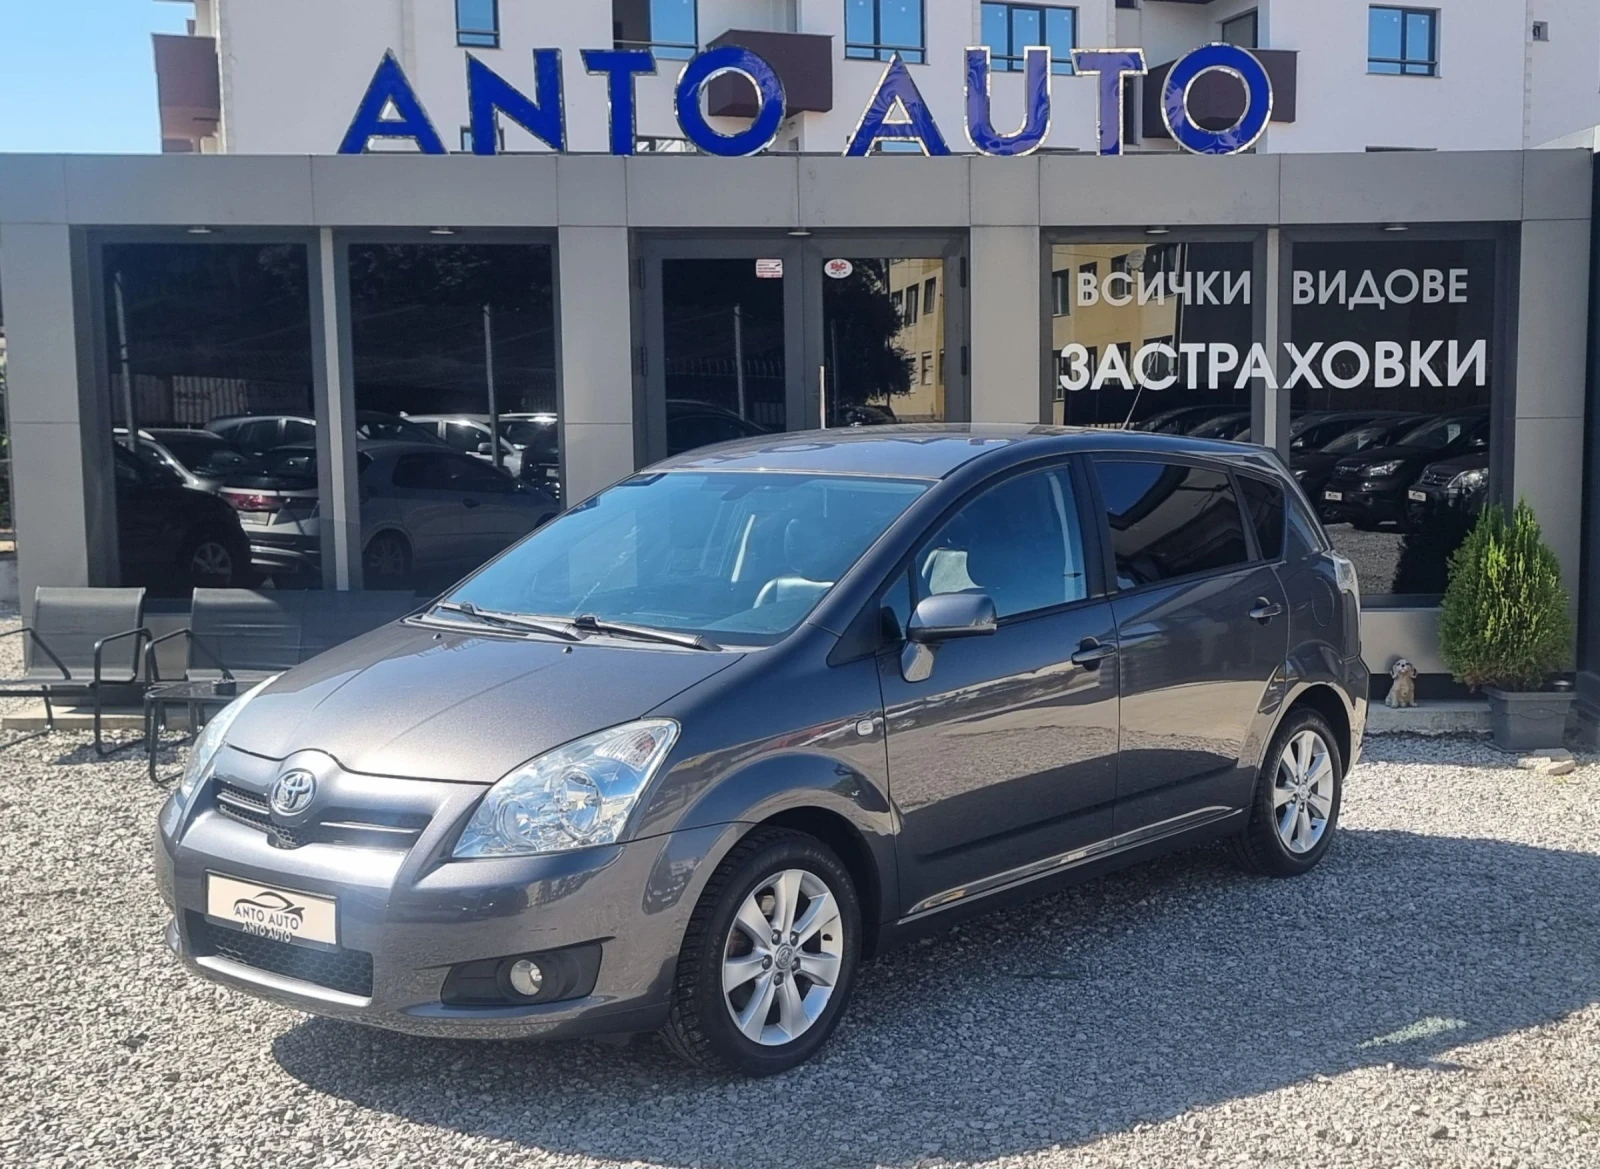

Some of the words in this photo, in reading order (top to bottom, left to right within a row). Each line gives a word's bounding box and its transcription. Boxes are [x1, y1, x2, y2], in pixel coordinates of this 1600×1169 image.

[337, 44, 787, 156] ANTO
[842, 41, 1274, 156] AUTO
[1077, 270, 1251, 307] ВСИЧКИ
[1292, 268, 1469, 310] ВИДОВЕ
[1059, 339, 1487, 391] ЗАСТРАХОВКИ
[234, 905, 265, 922] ANTO
[268, 914, 299, 930] AUTO
[242, 921, 266, 936] ANTO
[267, 928, 291, 943] AUTO
